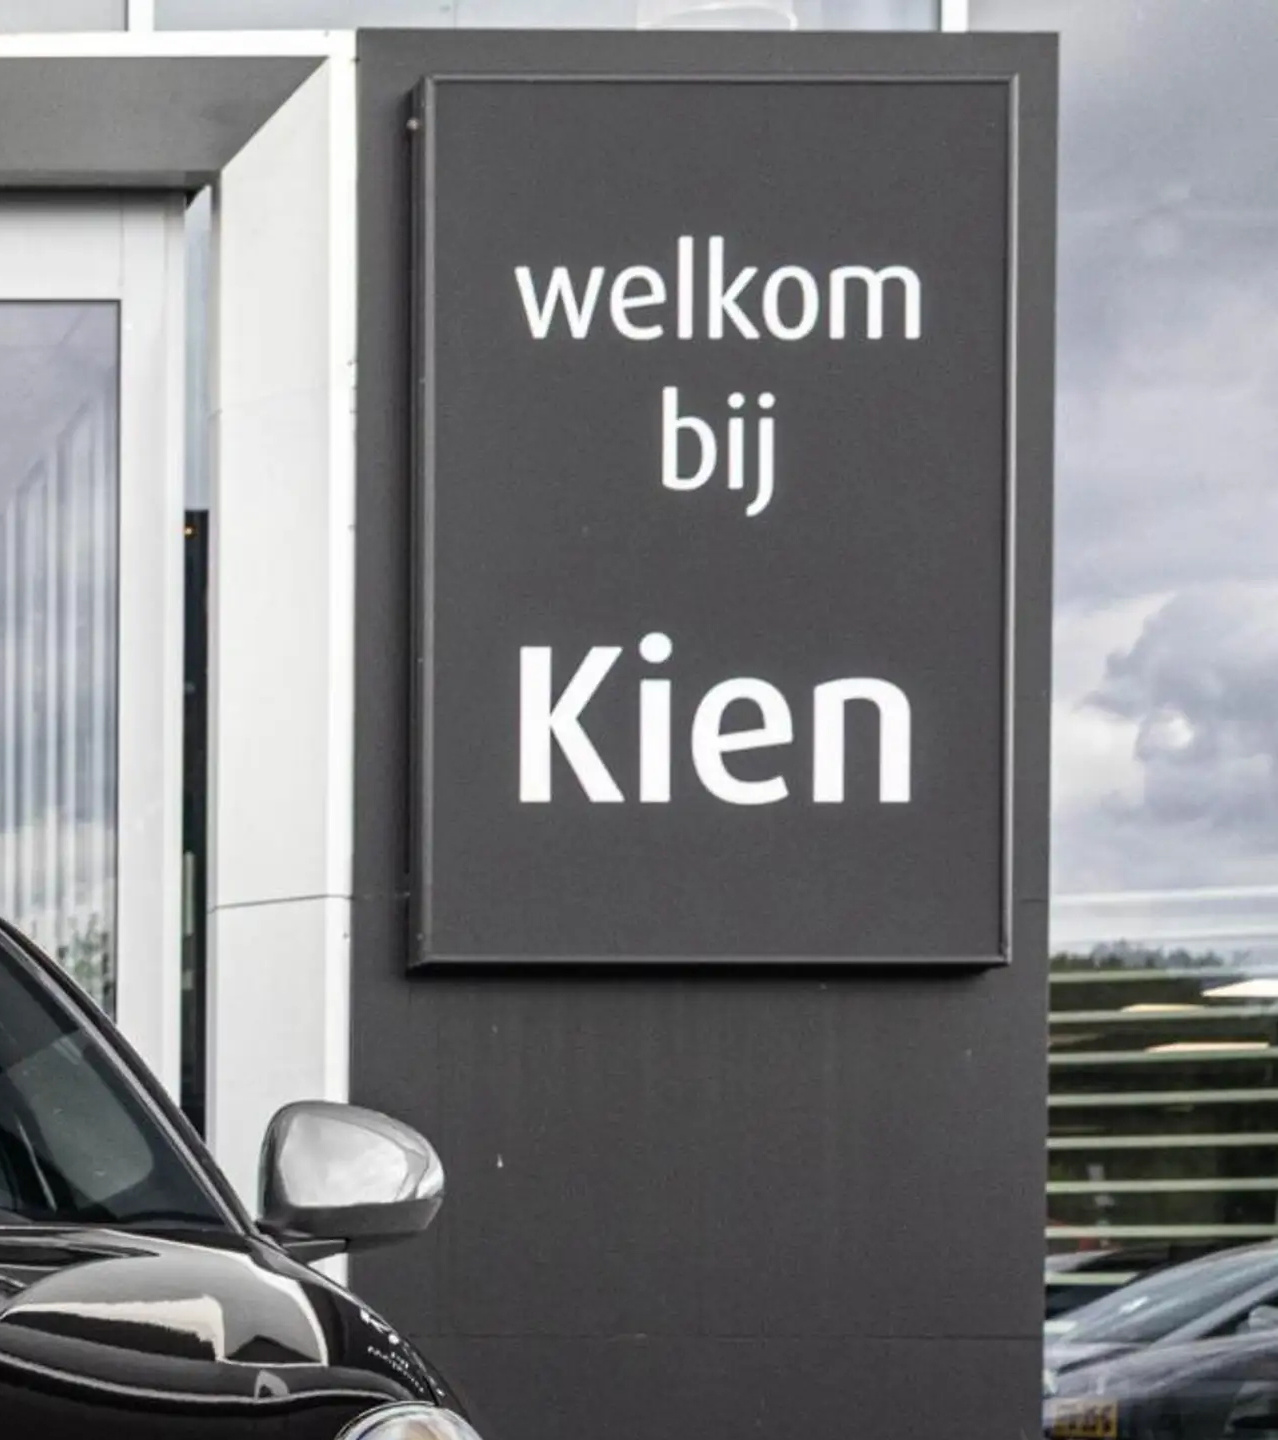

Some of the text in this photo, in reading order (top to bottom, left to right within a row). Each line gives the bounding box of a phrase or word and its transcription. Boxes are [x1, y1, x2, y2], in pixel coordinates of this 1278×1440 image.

[515, 235, 921, 341] welkom
[661, 386, 776, 517] bij
[519, 632, 911, 805] Kien
